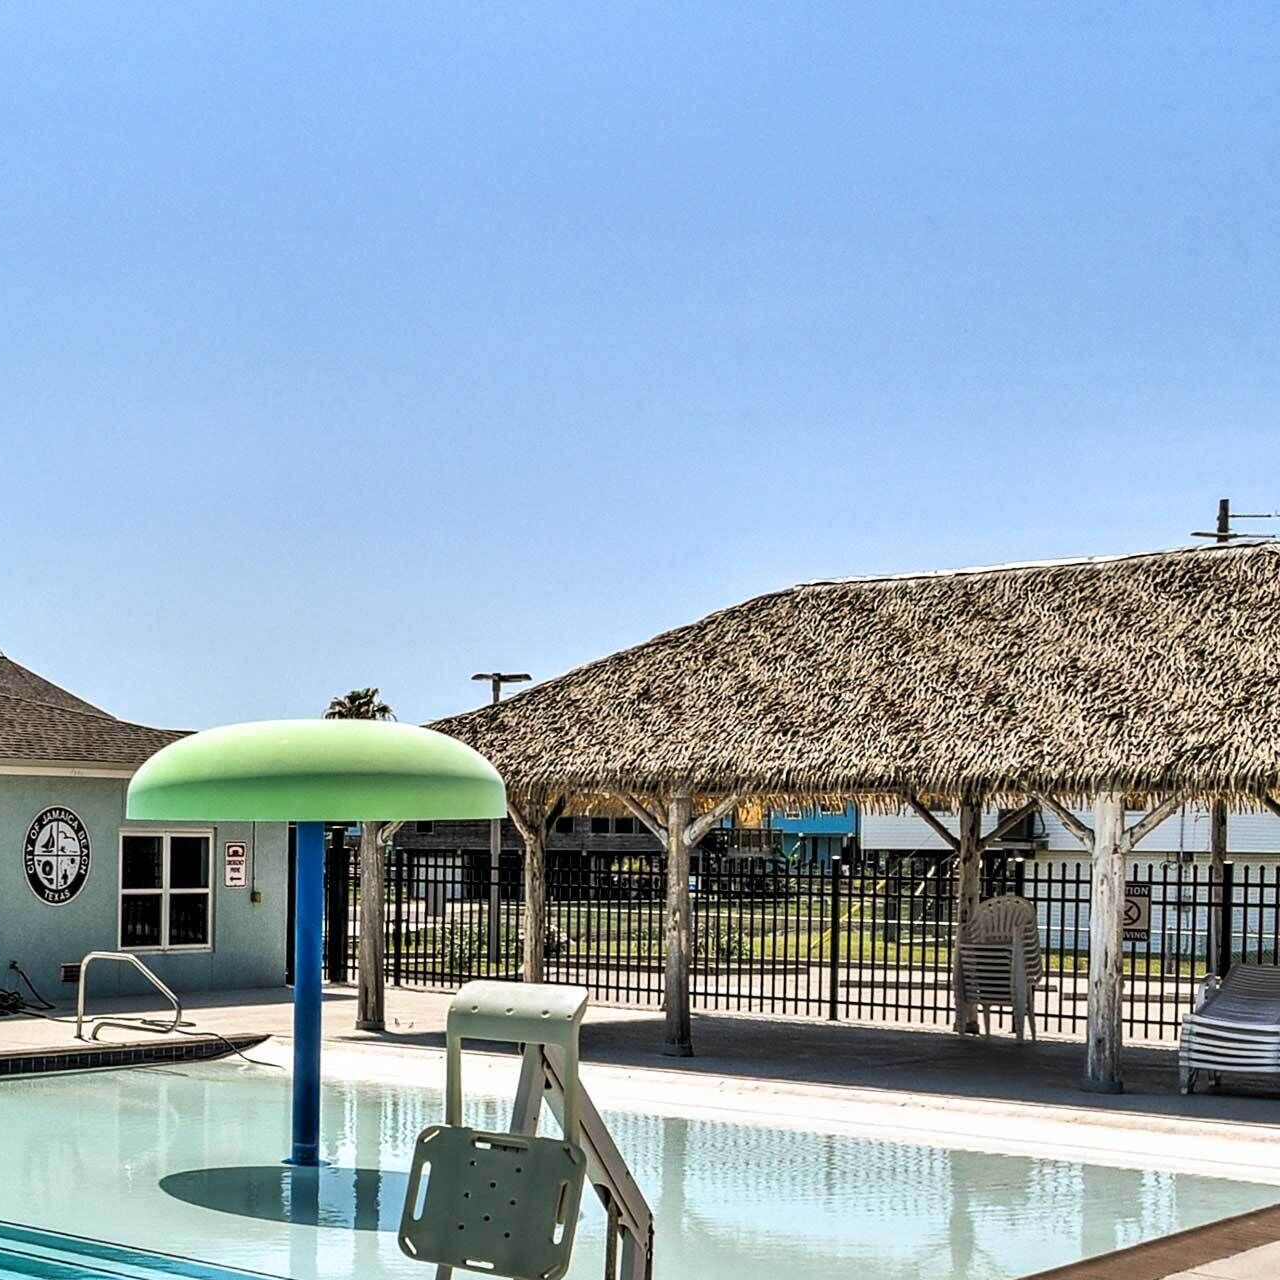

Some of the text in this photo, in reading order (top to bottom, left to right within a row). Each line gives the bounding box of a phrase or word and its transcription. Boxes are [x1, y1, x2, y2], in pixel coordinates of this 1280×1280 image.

[26, 809, 88, 875] CITY OF JAMAICA BEACH
[44, 889, 71, 901] TEXAS
[1125, 886, 1149, 896] TION
